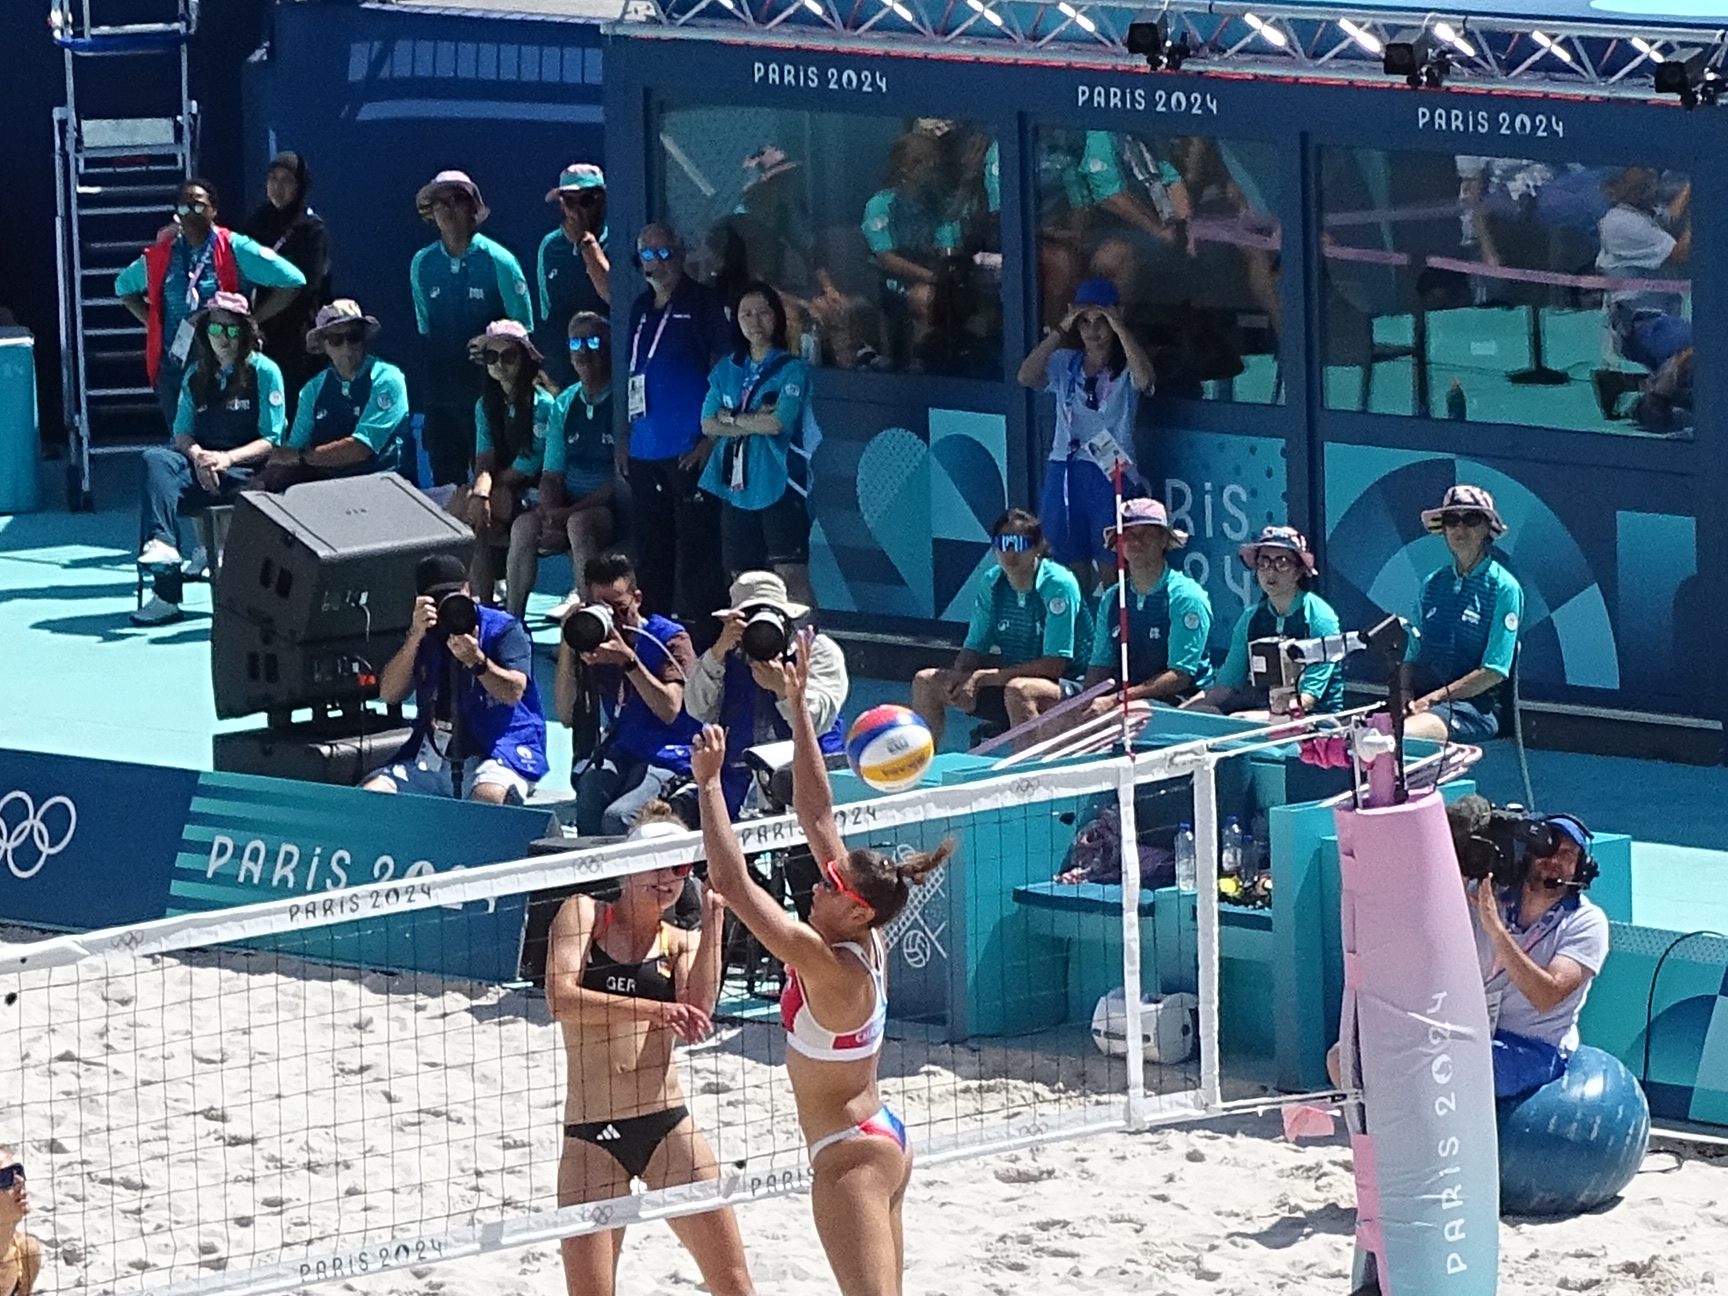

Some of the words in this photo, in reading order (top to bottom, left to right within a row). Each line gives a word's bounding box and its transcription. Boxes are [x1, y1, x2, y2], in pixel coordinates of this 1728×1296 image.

[753, 62, 818, 88] PARIS
[828, 68, 886, 92] 2024
[1078, 85, 1145, 110] PARIS
[1155, 90, 1217, 114] 2024
[1418, 107, 1489, 134] PARIS
[1499, 112, 1564, 137] 2024
[1138, 476, 1249, 540] RIS
[741, 820, 805, 844] PARI
[207, 834, 351, 891] PARIS
[289, 893, 360, 922] PARIS
[371, 884, 431, 908] 2024
[606, 976, 636, 992] GER
[1437, 1136, 1468, 1275] PARIS
[299, 1252, 368, 1282] PARIS
[379, 1240, 442, 1265] 2024
